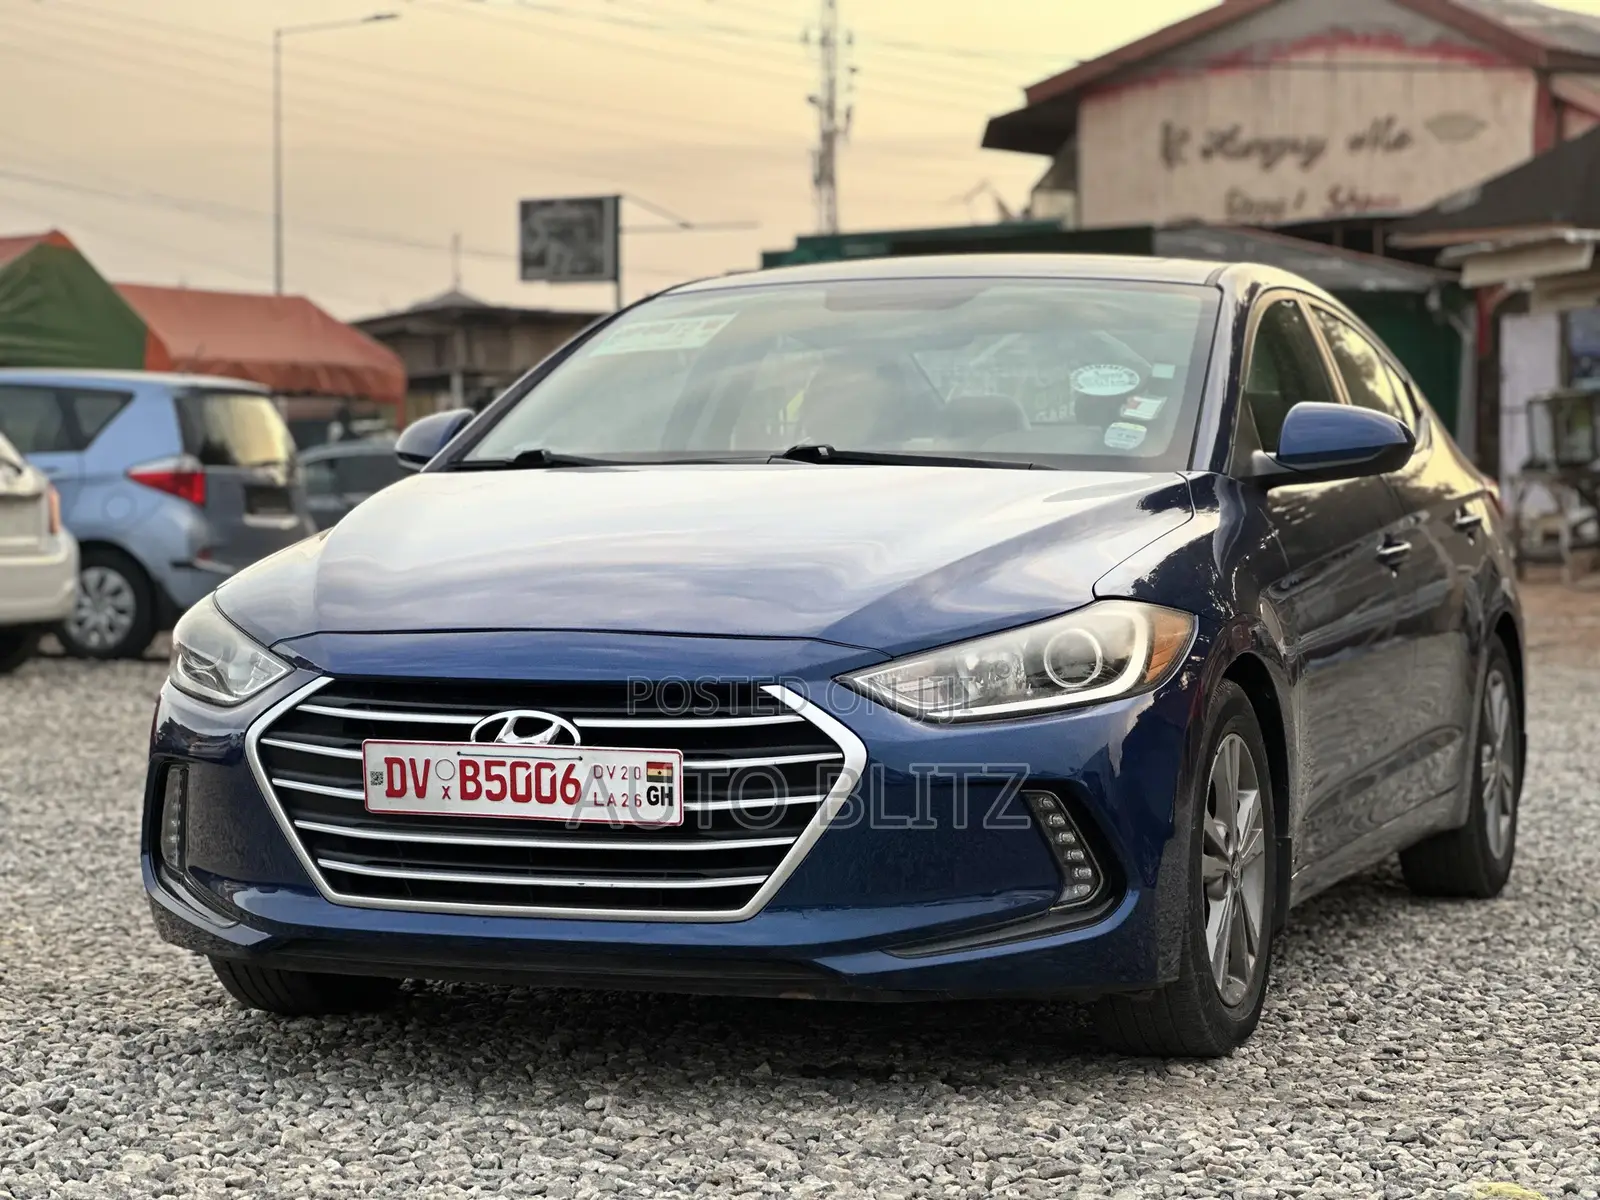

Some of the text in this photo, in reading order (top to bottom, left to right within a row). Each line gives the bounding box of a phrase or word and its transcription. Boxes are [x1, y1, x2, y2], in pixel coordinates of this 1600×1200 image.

[384, 756, 431, 799] DV
[458, 758, 582, 806] B5006
[646, 785, 674, 807] GH
